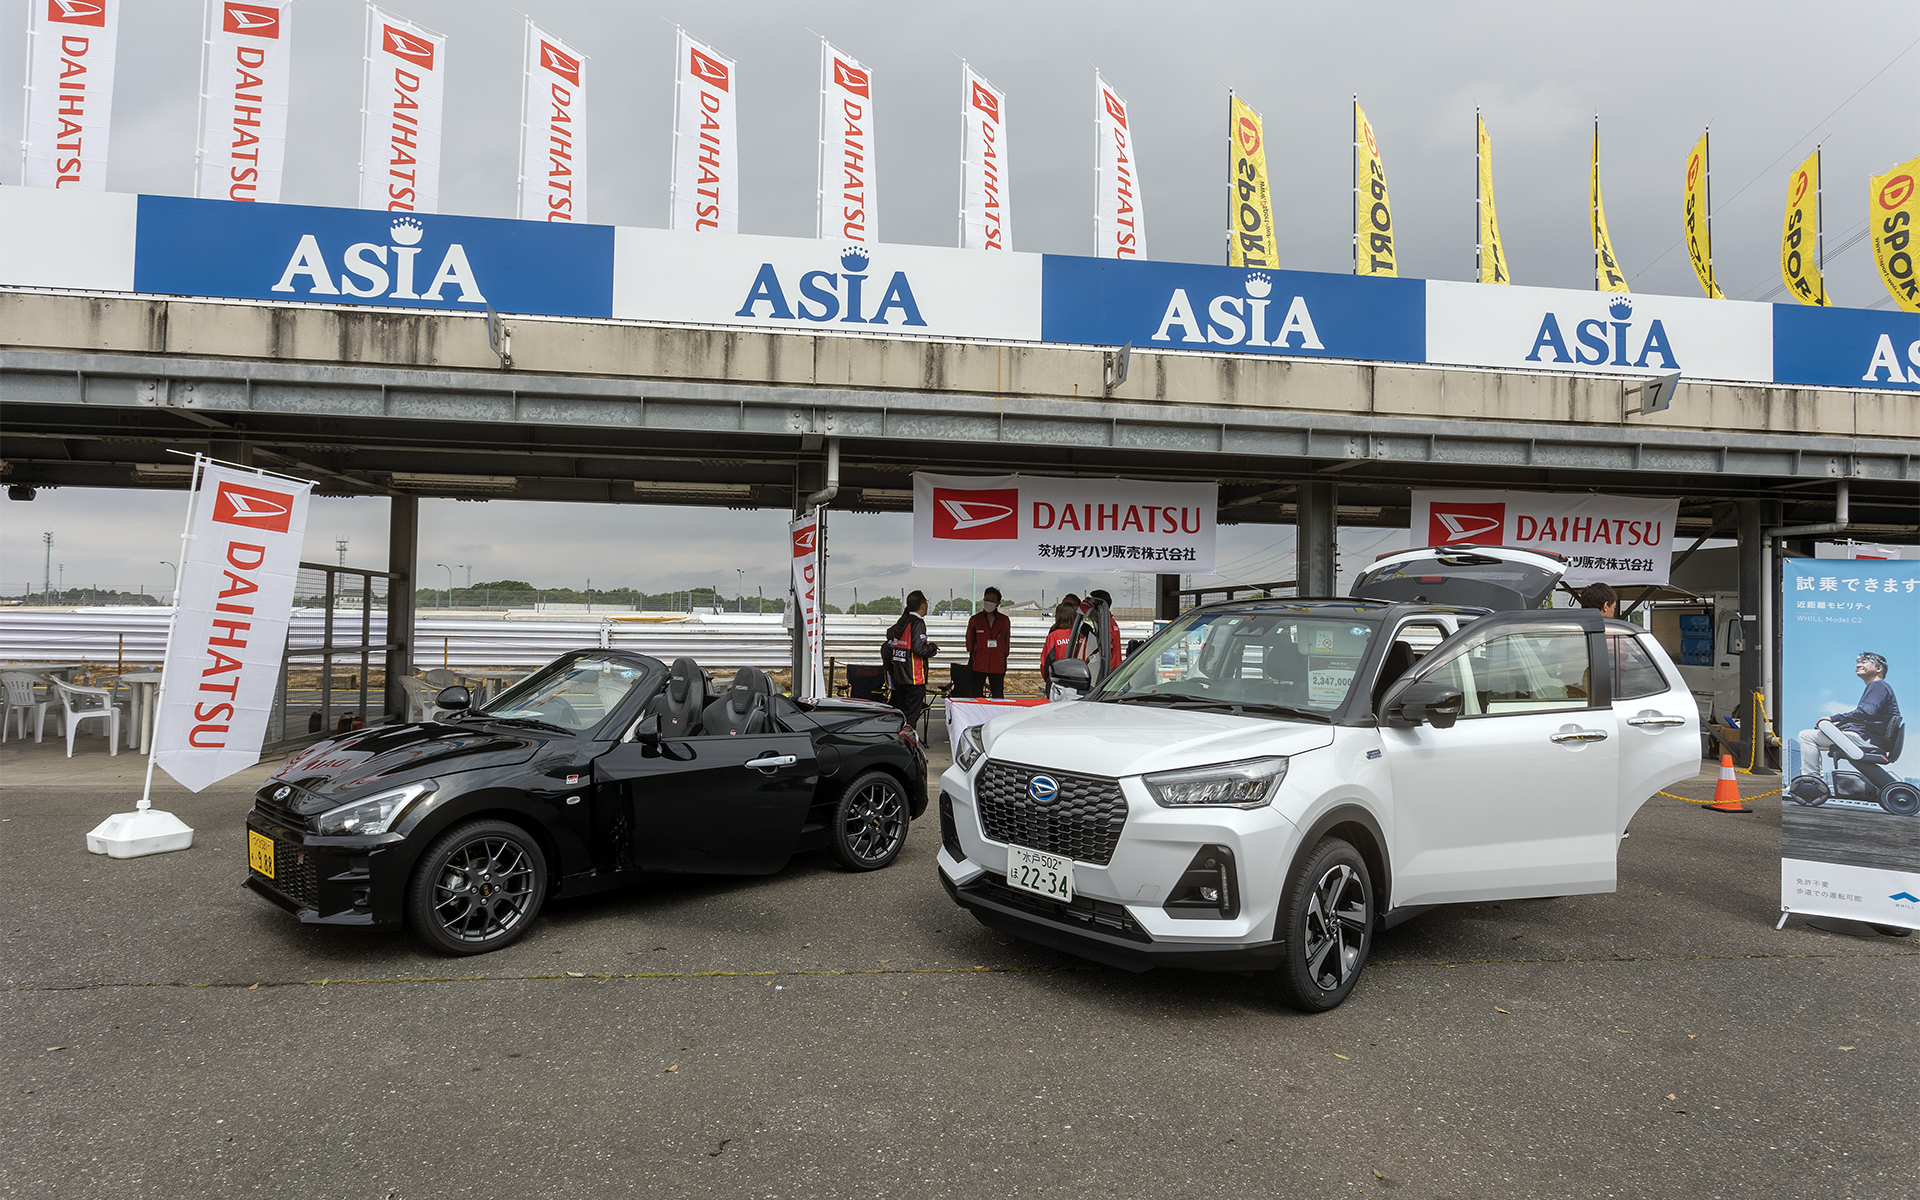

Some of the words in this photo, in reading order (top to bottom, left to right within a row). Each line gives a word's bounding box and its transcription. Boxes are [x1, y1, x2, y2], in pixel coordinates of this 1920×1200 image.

[56, 36, 90, 189] DAIHATSU
[230, 46, 265, 203] DAIHATSU
[388, 67, 420, 212] DAIHATSU
[548, 85, 572, 222] DAIHATSU
[695, 91, 721, 232] DAIHATSU
[843, 98, 867, 242] DAIHATSU
[983, 120, 1001, 251] DAIHATSU
[1114, 127, 1136, 260] DAIHATSU
[271, 235, 487, 304] ASIA
[736, 263, 927, 326] ASIA
[493, 319, 500, 347] 5
[1151, 289, 1326, 352] ASIA
[1526, 312, 1680, 369] ASIA
[1117, 353, 1124, 379] 6
[1649, 382, 1663, 407] 7
[1033, 501, 1201, 534] DAIHATSU
[1516, 515, 1662, 546] DAIHATSU
[1037, 543, 1197, 561] 茨城ダイハツ販売株式会社
[1796, 576, 1920, 594] 試乗できます
[1796, 600, 1872, 611] 近距離モビリティ
[189, 541, 266, 749] DAIHATSU
[1796, 615, 1823, 623] WHILL
[1021, 865, 1068, 898] 22-34
[1796, 878, 1830, 889] 免許不要
